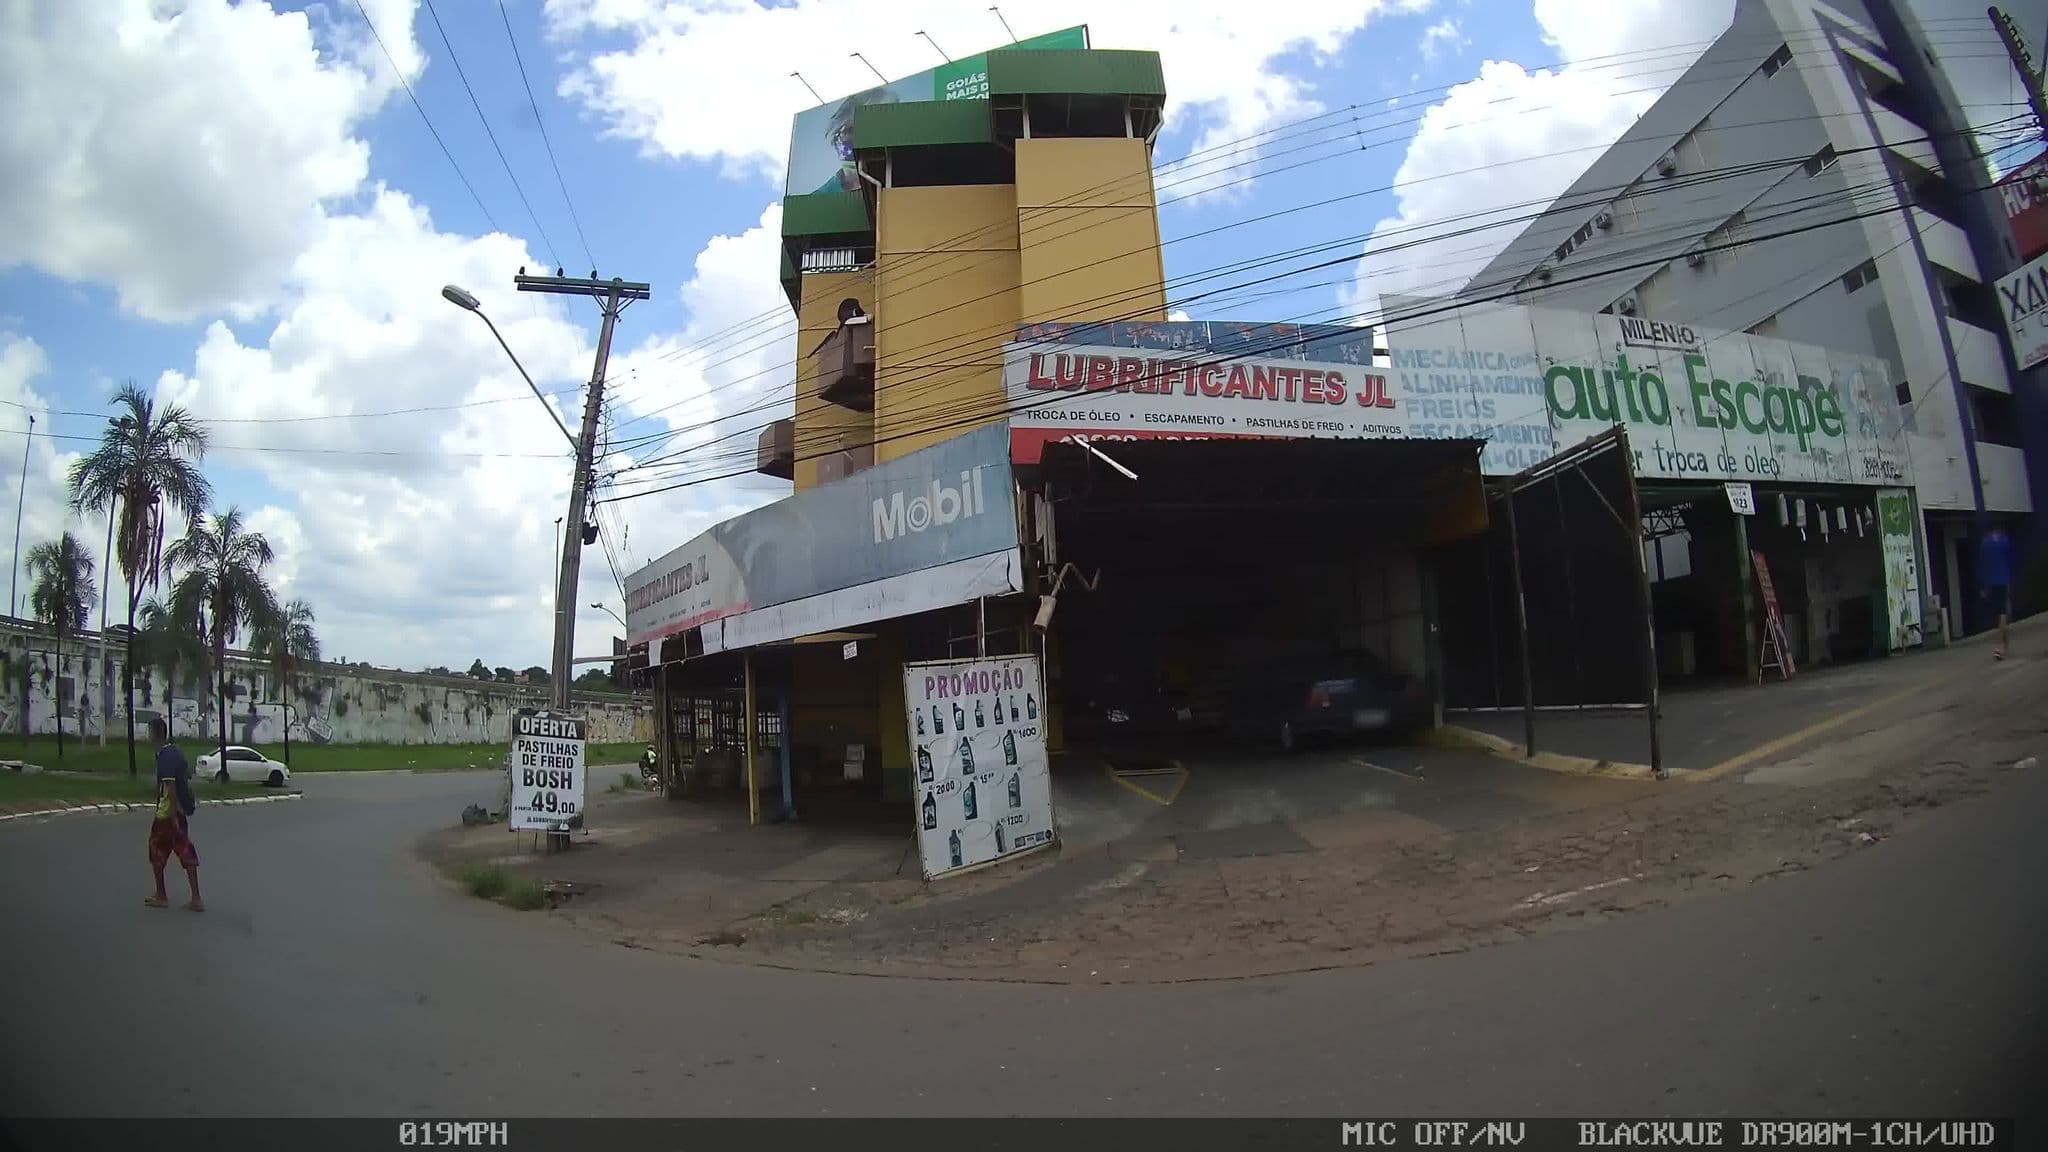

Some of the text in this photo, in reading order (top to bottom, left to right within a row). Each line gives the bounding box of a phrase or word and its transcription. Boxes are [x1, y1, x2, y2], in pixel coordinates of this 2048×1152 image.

[947, 72, 986, 90] GOIÁS
[947, 85, 978, 100] MAIS
[1619, 318, 1696, 345] MILENIO
[1027, 352, 1395, 408] LUBRIFICANTES JL
[1400, 373, 1545, 396] ALINHAMENTO
[1407, 399, 1497, 419] FREIOS
[1545, 354, 1843, 453] auto Escape
[1026, 409, 1401, 434] TROCA DE ÓLEO ESCAPAMENTO PASTILHAS DE FREIO ADITIVOS
[1653, 440, 1708, 473] troca
[1717, 446, 1737, 473] de
[872, 465, 984, 544] Mobil
[925, 662, 1024, 700] PROMOÇÃO
[519, 717, 577, 738] OFERTA
[518, 740, 578, 756] PASTILHAS
[522, 754, 573, 769] DE FREIO
[523, 768, 572, 790] BOSH
[531, 791, 575, 815] 49,00
